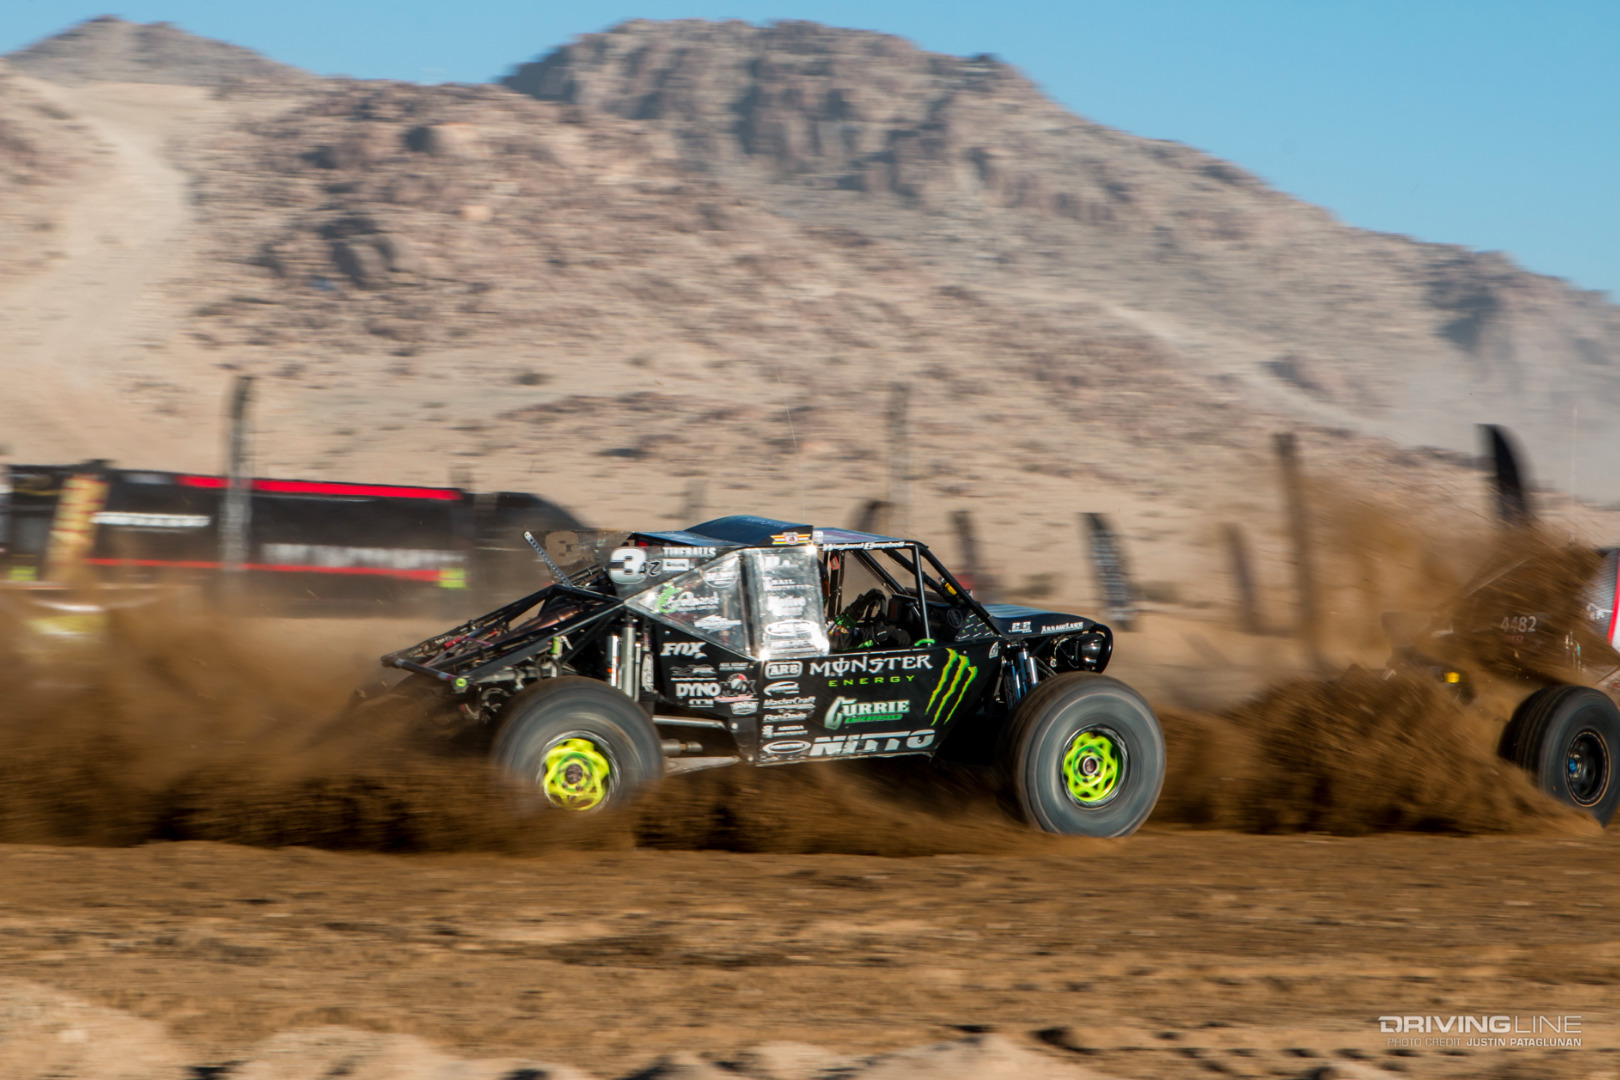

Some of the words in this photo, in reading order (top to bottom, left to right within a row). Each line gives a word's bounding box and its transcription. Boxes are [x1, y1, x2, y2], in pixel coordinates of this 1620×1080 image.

[608, 546, 647, 584] 3
[660, 641, 707, 659] FOX
[769, 664, 799, 676] ARB
[809, 654, 934, 677] MONSTER
[675, 682, 721, 697] DYNO
[828, 675, 915, 687] ENERGY
[824, 695, 911, 730] CURRIE
[809, 728, 936, 756] NITTO
